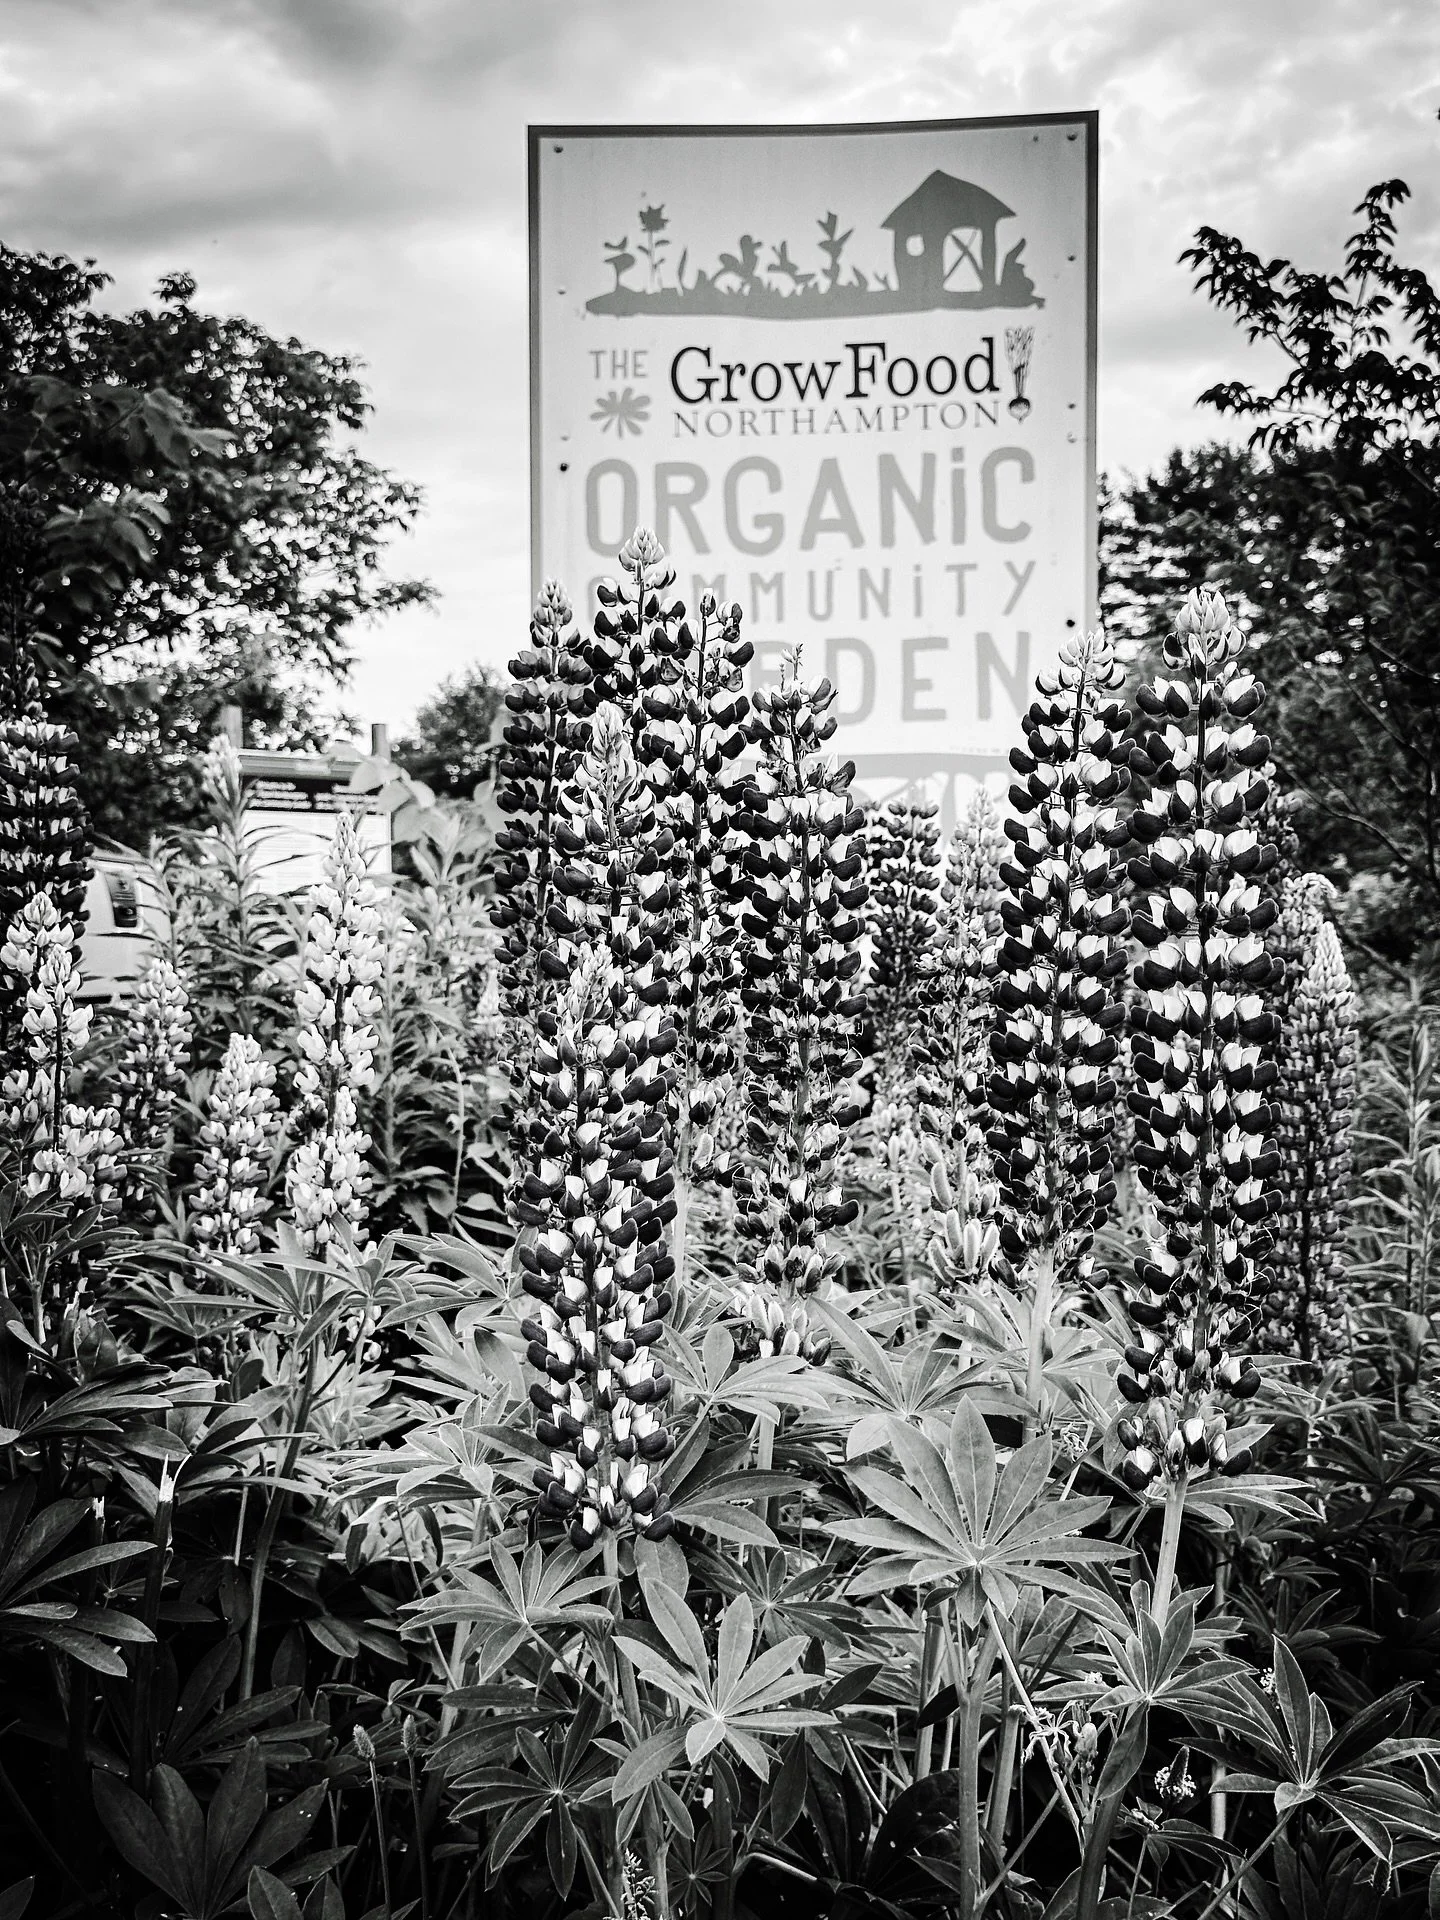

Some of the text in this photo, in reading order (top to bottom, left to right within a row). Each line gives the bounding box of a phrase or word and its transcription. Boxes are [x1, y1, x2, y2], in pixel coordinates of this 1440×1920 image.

[589, 350, 648, 379] THE
[671, 337, 1000, 404] GrowFood
[673, 401, 1000, 438] NORTHAMPTON
[586, 560, 1036, 624] MMUNiTY
[688, 631, 1032, 723] RDEN
